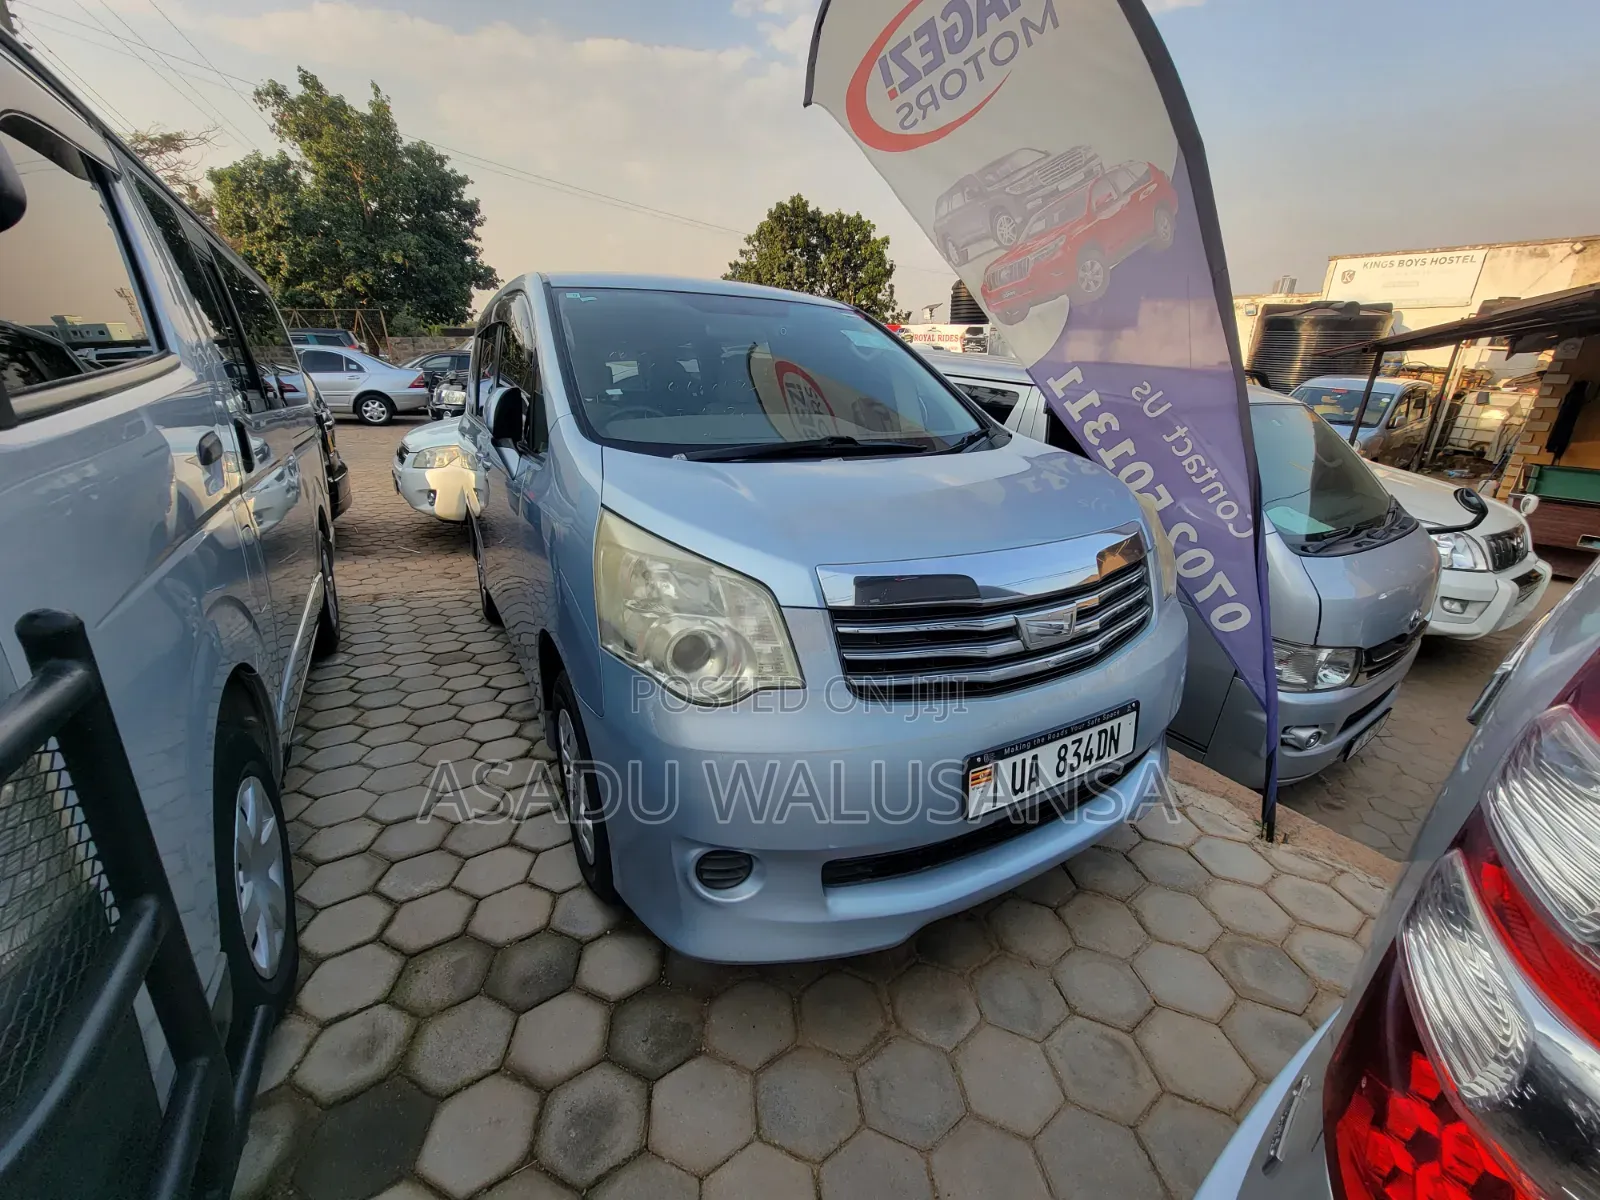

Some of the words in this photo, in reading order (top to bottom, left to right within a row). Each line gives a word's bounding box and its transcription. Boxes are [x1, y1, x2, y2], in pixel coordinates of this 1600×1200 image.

[1362, 260, 1395, 270] KINGS
[1397, 257, 1427, 268] BOYS
[1429, 254, 1477, 266] HOSTEL
[913, 333, 936, 342] ROYAL
[937, 334, 959, 343] RIDES
[1003, 741, 1031, 755] Making
[1033, 737, 1045, 746] the
[1047, 728, 1068, 741] Roads
[1070, 723, 1085, 733] Your
[1087, 717, 1101, 727] Safe
[1102, 709, 1120, 721] Space
[1011, 753, 1040, 796] UA
[1055, 722, 1122, 778] 834DN
